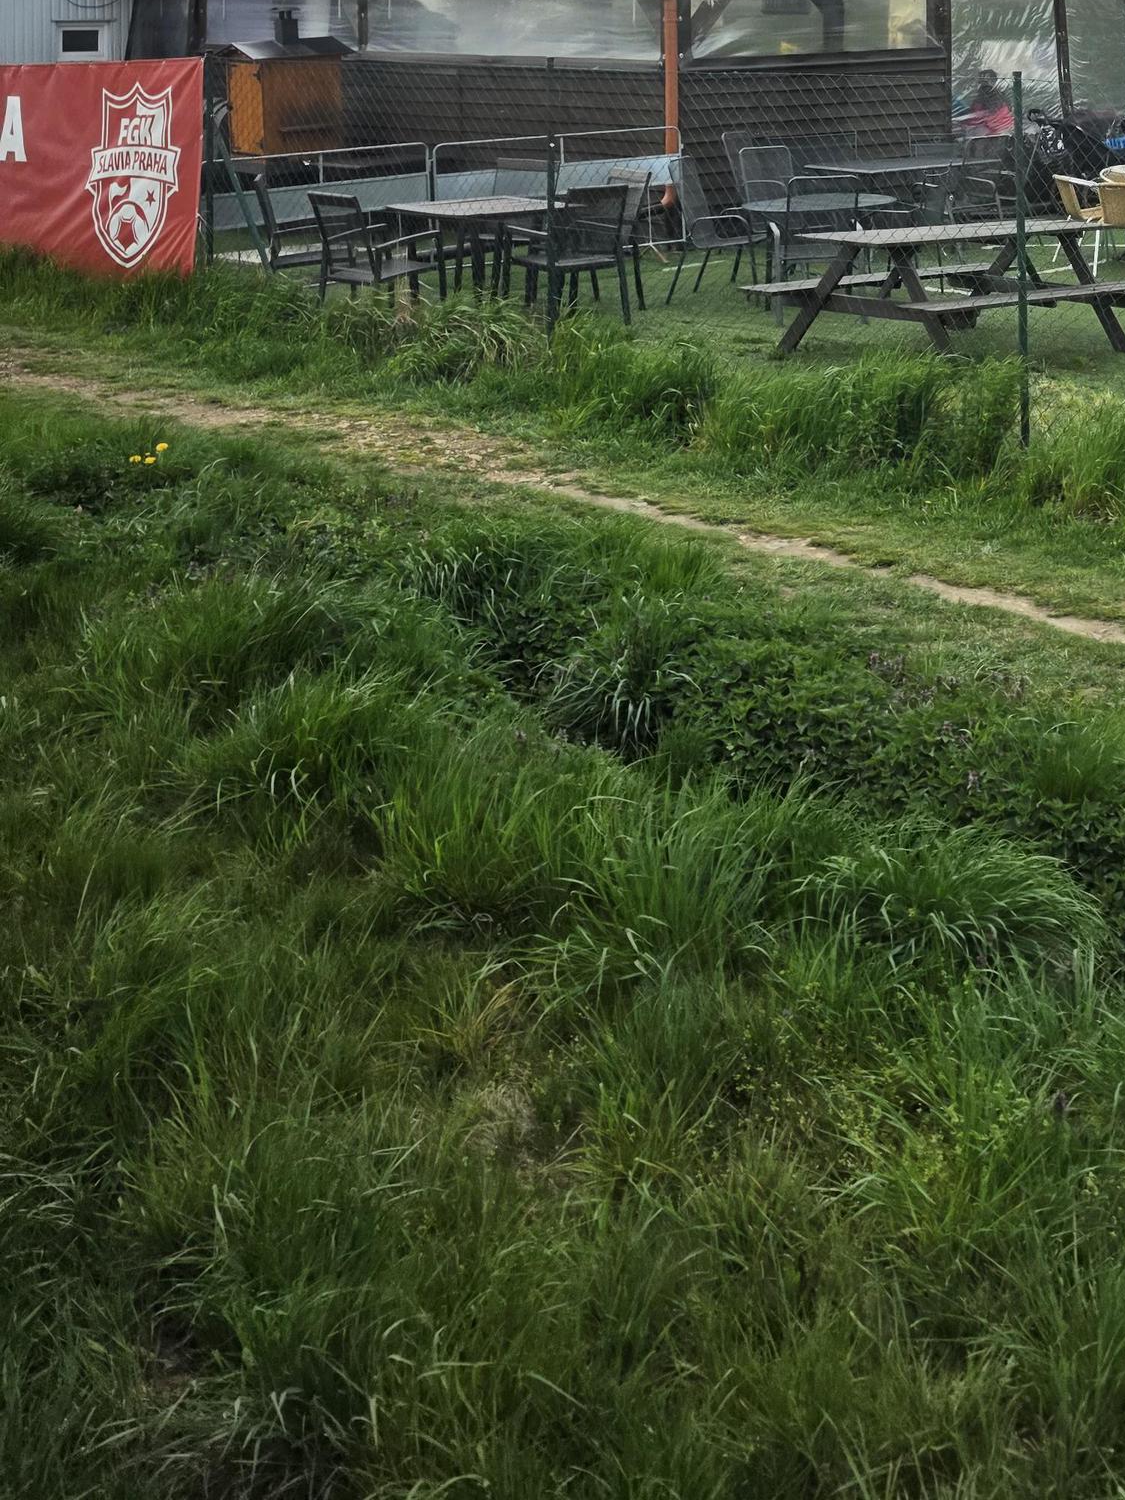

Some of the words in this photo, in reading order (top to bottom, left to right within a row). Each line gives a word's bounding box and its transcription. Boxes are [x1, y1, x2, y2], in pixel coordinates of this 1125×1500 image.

[118, 114, 154, 146] FGK
[97, 151, 132, 174] SLAVIA
[133, 151, 168, 176] PRAHA
